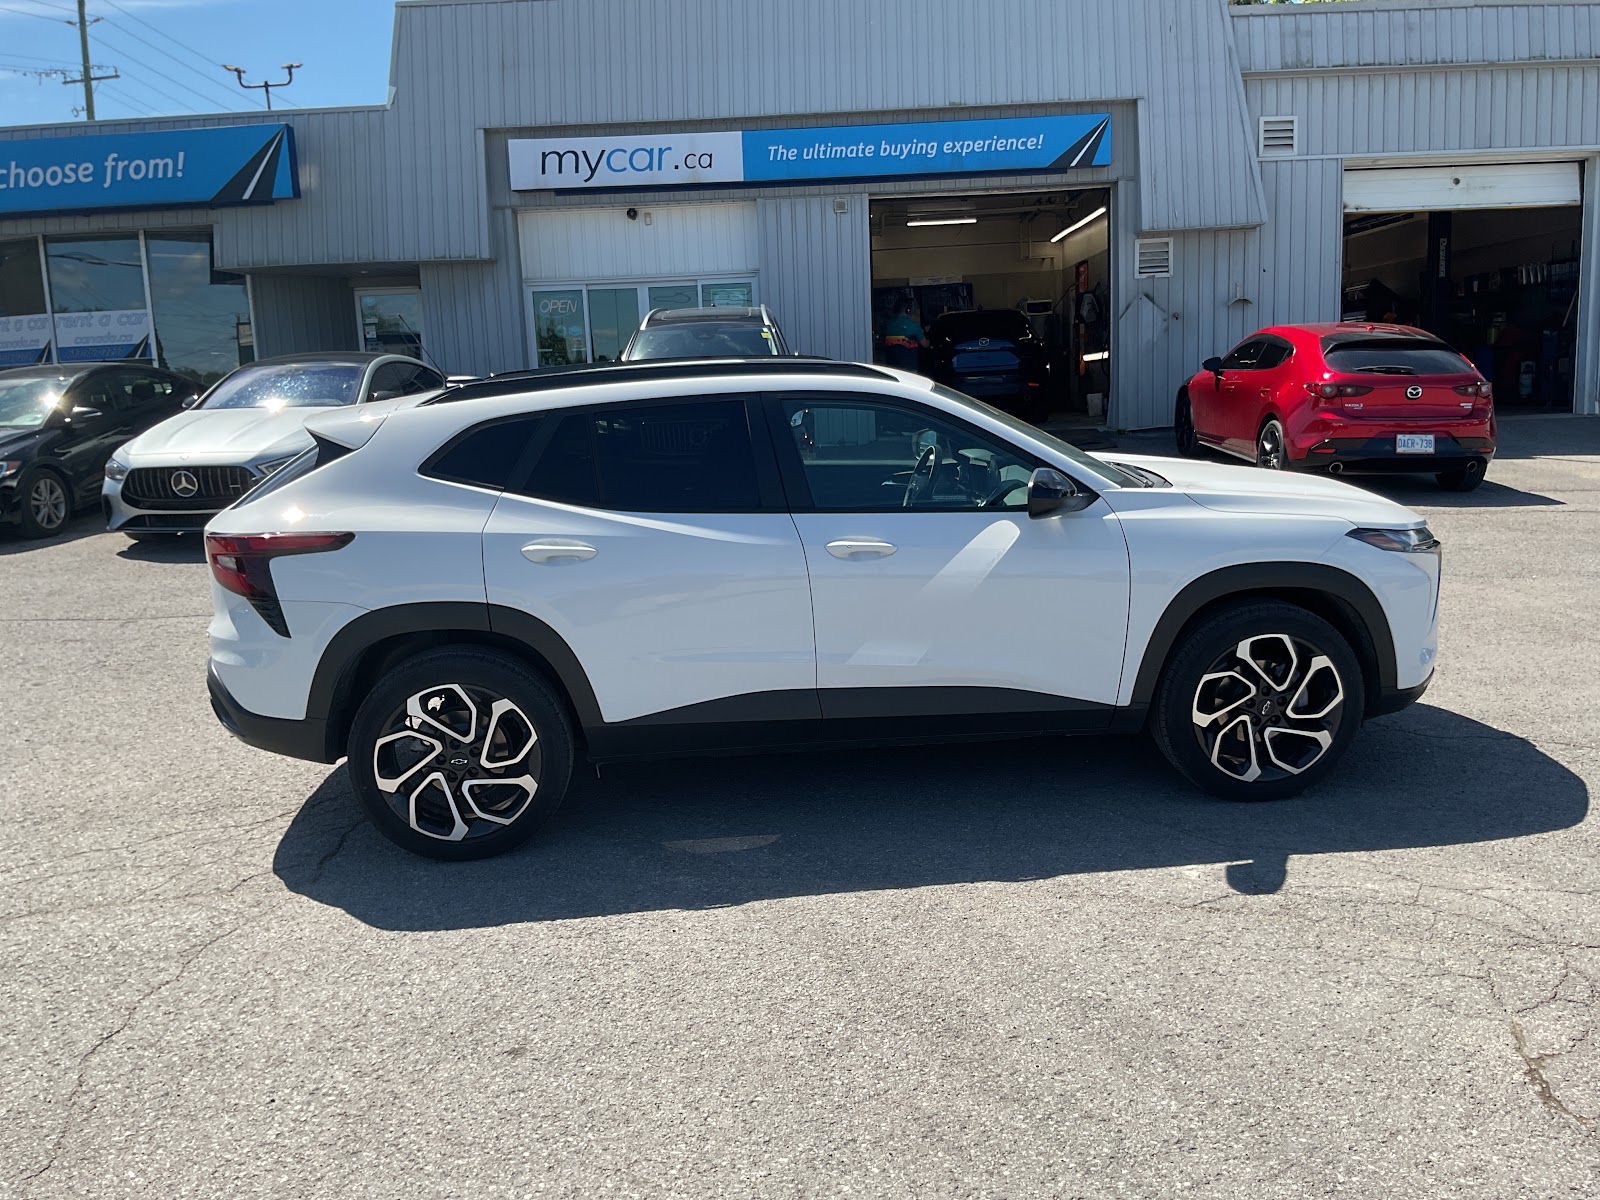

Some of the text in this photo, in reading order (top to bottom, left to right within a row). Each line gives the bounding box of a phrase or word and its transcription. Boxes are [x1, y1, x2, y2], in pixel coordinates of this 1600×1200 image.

[769, 134, 1044, 161] The ultimate buying experience!
[103, 152, 185, 188] from!
[539, 299, 578, 314] OPEN
[57, 312, 147, 328] rent a car
